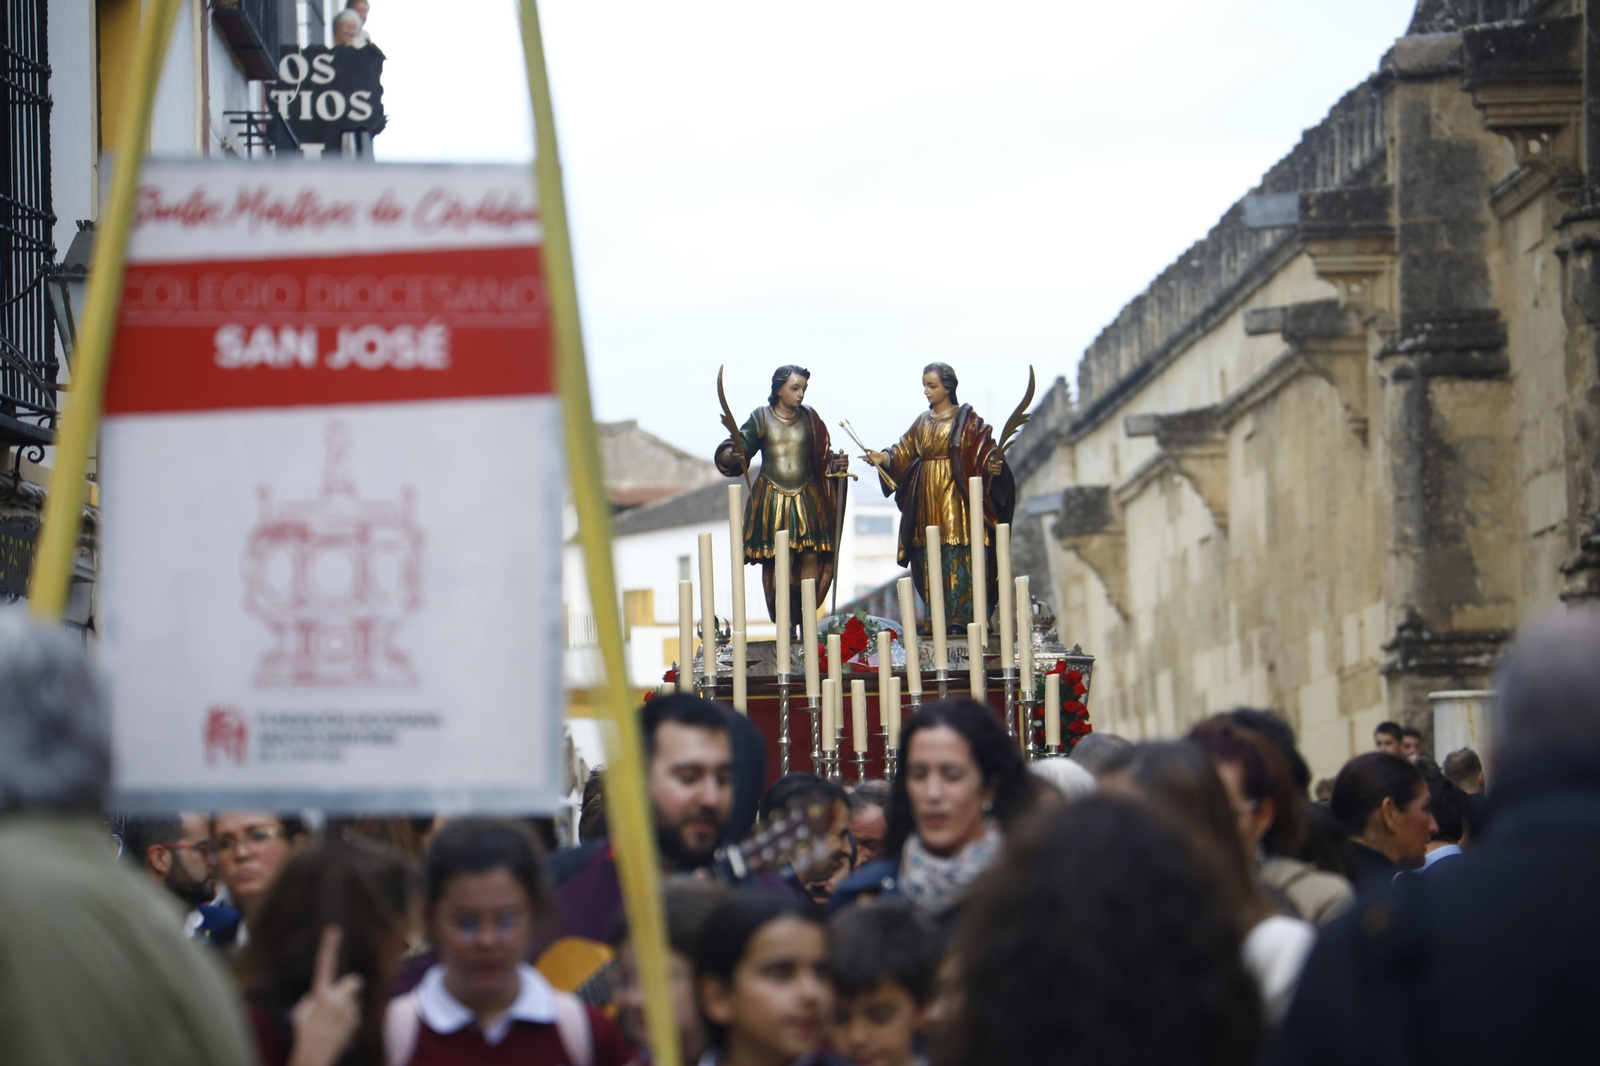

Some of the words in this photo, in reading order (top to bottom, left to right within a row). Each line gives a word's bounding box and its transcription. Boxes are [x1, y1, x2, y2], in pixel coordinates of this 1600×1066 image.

[278, 53, 336, 85] OS
[270, 90, 373, 121] TIOS
[213, 322, 319, 370] SAN
[324, 315, 452, 371] JOSÉ
